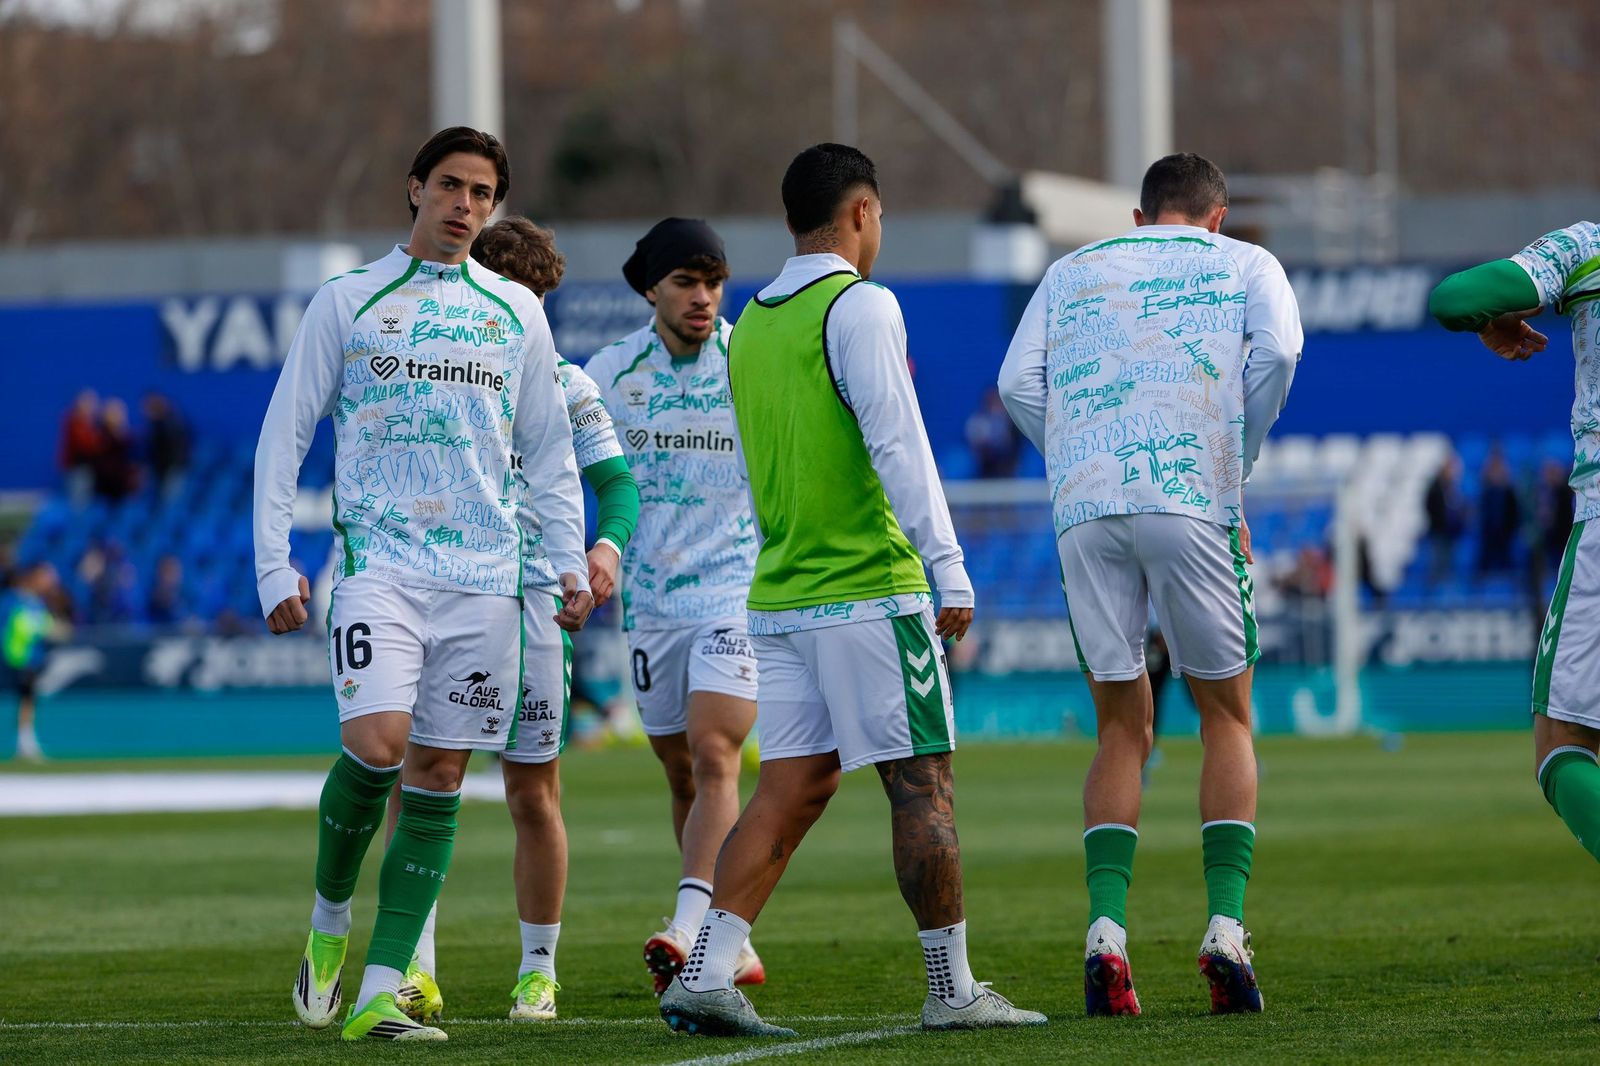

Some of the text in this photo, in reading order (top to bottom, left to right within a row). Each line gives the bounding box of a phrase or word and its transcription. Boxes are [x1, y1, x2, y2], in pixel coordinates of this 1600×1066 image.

[1058, 295, 1106, 316] CABEZAS
[1137, 291, 1246, 320] ESPARTINAS
[1178, 308, 1245, 335] CAMA
[406, 359, 503, 391] trainline
[381, 427, 473, 449] AZNALFARACHE
[654, 429, 734, 451] trainlin
[1114, 433, 1203, 462] SANLUCAR
[336, 448, 498, 504] SEVILLA
[1121, 457, 1202, 485] LA MAYOR
[1162, 477, 1211, 513] GELVES
[332, 622, 373, 676] 16
[718, 636, 748, 648] AUS
[449, 691, 504, 711] GLOBAL
[472, 686, 501, 698] AUS
[480, 727, 498, 735] hummel
[325, 815, 373, 834] BETIS
[405, 863, 446, 882] BETIS
